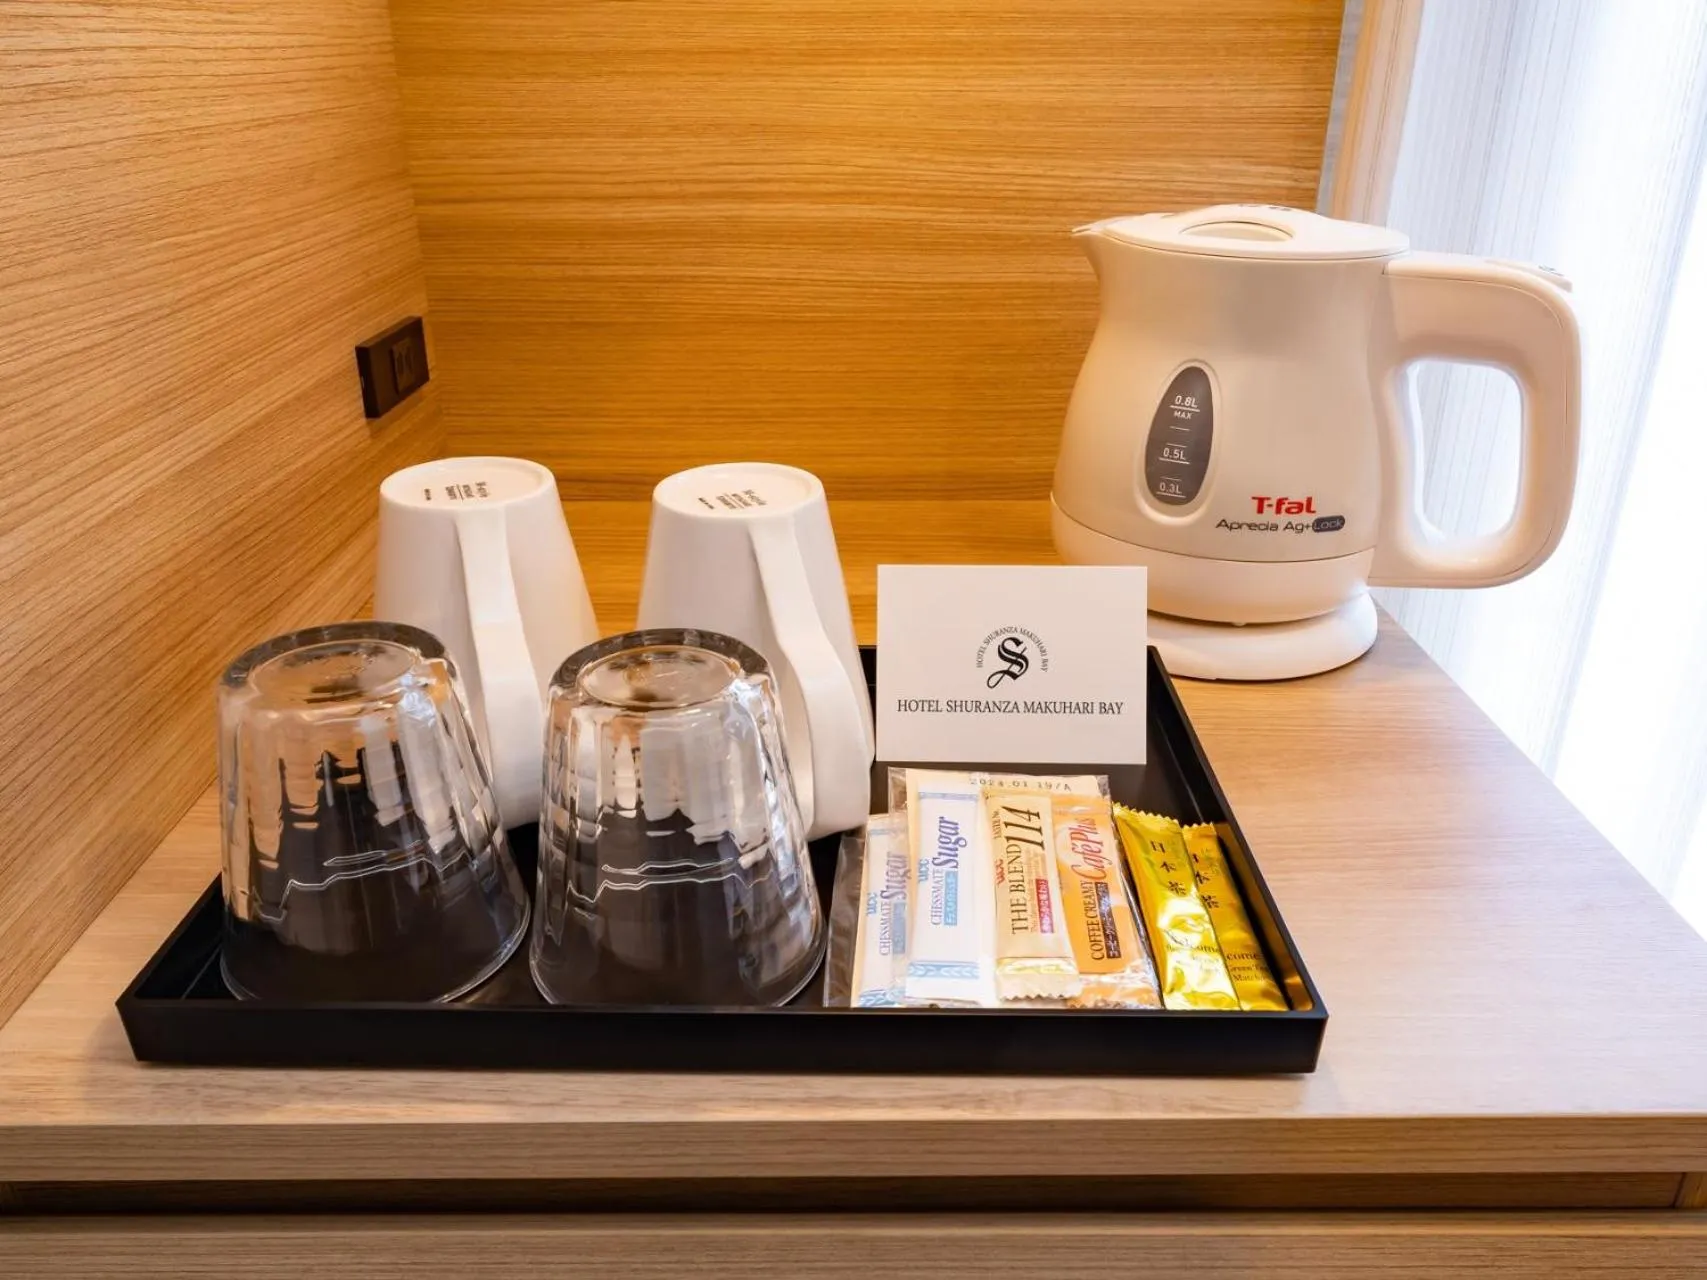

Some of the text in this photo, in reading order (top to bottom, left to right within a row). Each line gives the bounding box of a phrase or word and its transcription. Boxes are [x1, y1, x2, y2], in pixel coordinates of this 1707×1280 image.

[1175, 395, 1198, 408] 0.8L
[1173, 411, 1192, 420] MAX
[1163, 448, 1186, 460] 0.5L
[1159, 482, 1182, 494] 0.3L
[1251, 496, 1317, 515] T-fal
[1215, 518, 1279, 532] Aprecia
[896, 699, 1124, 715] HOTEL SHURANZA MAKUHARI BAY
[1001, 805, 1045, 851] 114
[931, 816, 967, 869] Sugar
[880, 852, 913, 900] Sugar
[1006, 843, 1026, 893] BLEND
[1080, 880, 1098, 919] CREAMY
[1009, 898, 1029, 934] THE
[1085, 919, 1105, 961] COFFEE
